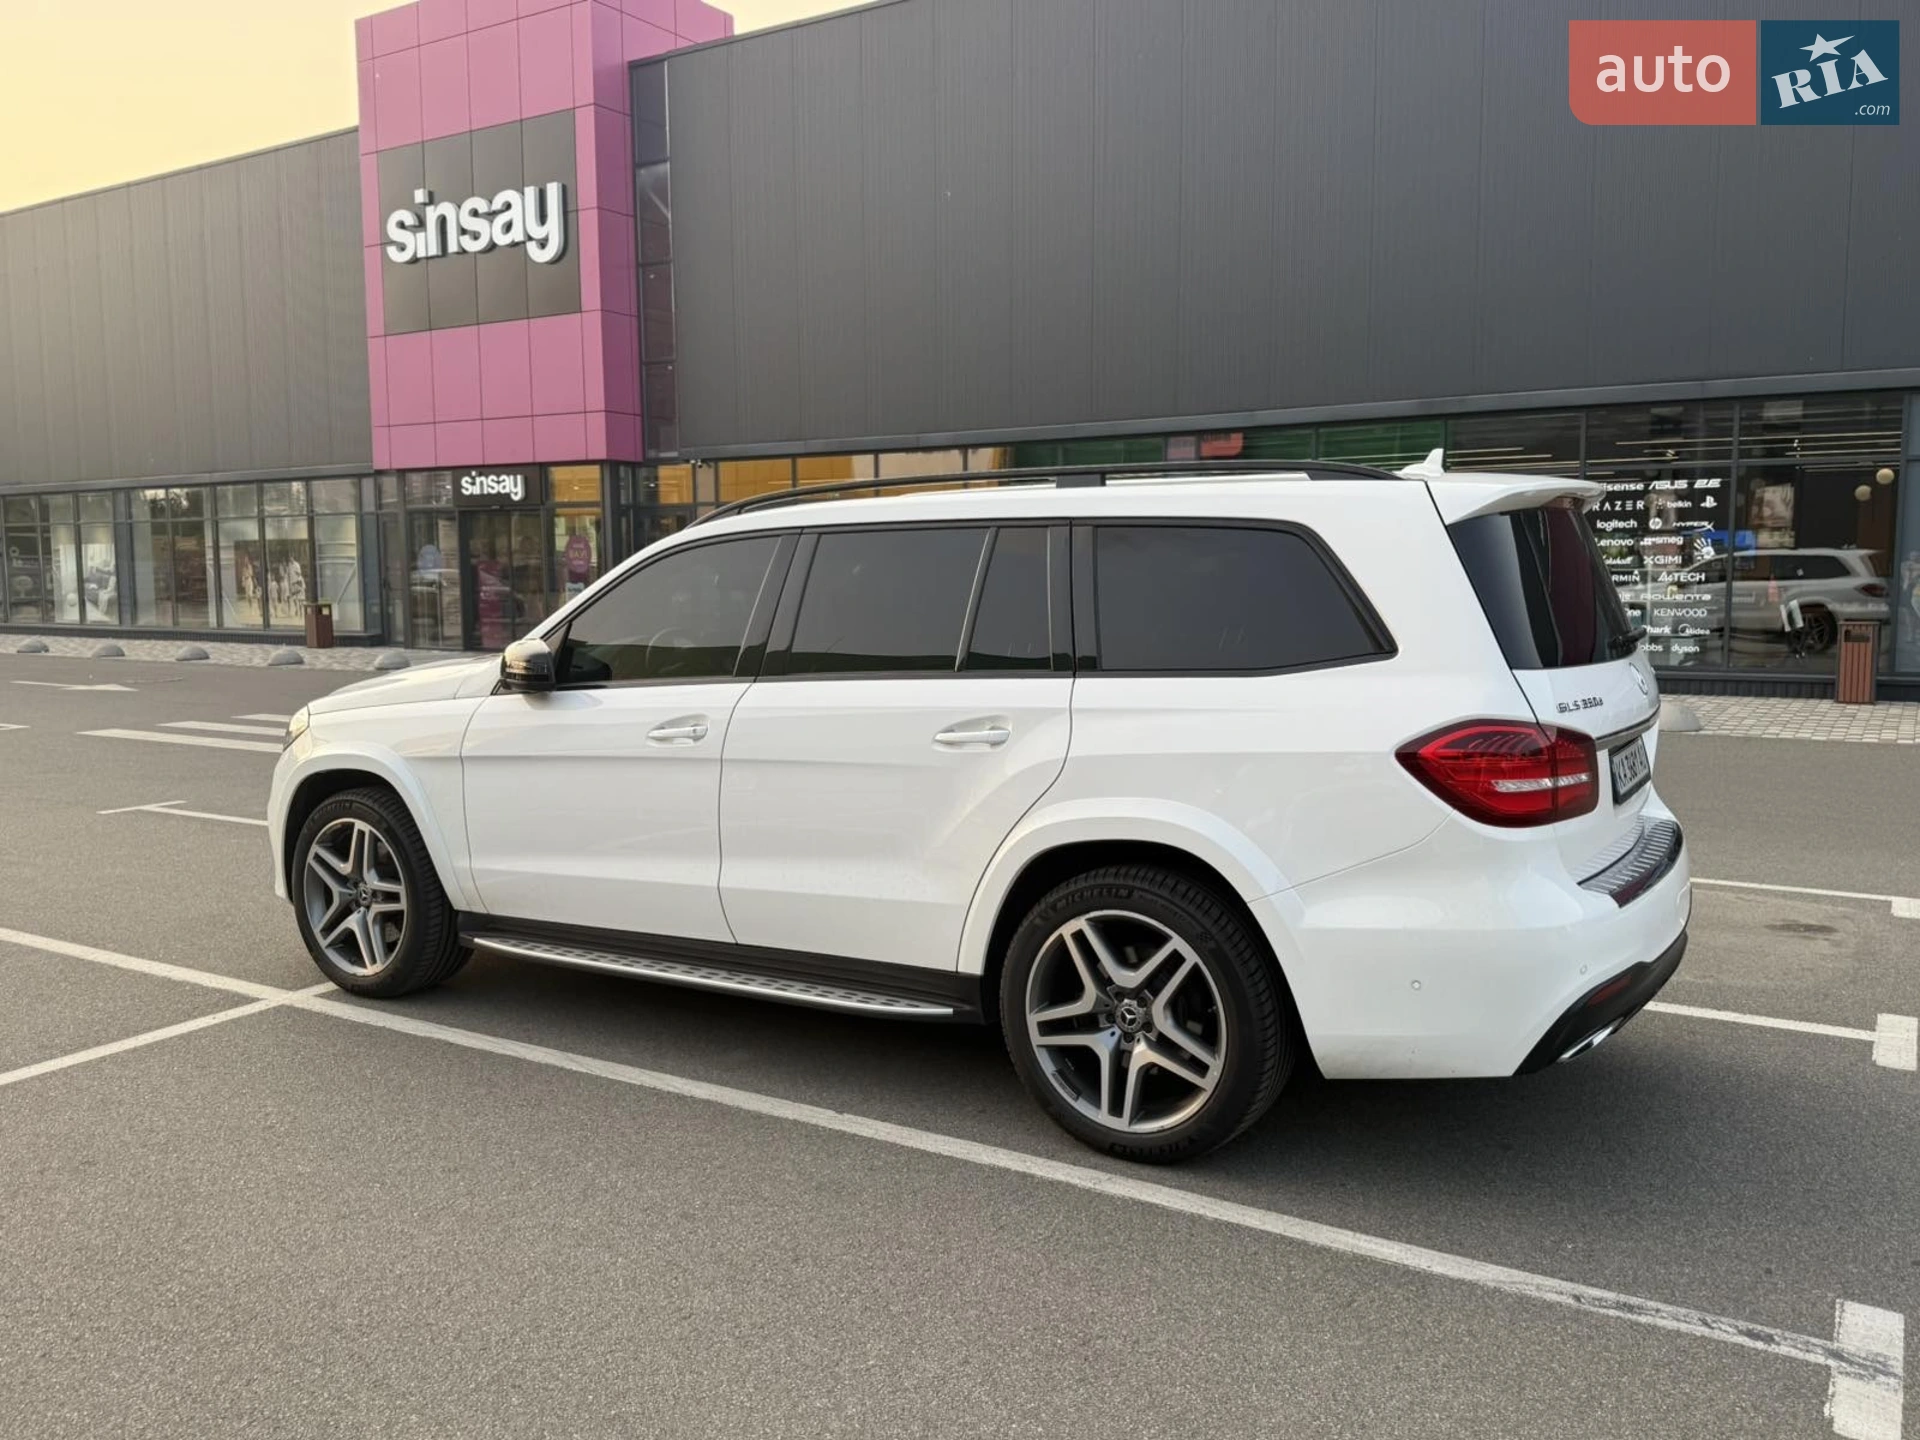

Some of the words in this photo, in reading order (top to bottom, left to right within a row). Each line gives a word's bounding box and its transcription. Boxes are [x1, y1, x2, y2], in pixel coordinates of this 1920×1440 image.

[386, 182, 565, 263] sinsay
[461, 470, 525, 501] sinsay
[1603, 483, 1645, 491] isense
[1648, 480, 1688, 490] ASUS
[1667, 499, 1692, 508] belkin
[1596, 519, 1638, 532] logitech
[1654, 536, 1684, 546] smeg
[1643, 555, 1682, 564] XGIMI
[1653, 608, 1707, 617] KENWOOD
[1670, 643, 1700, 654] dyson
[1556, 701, 1581, 714] GLS
